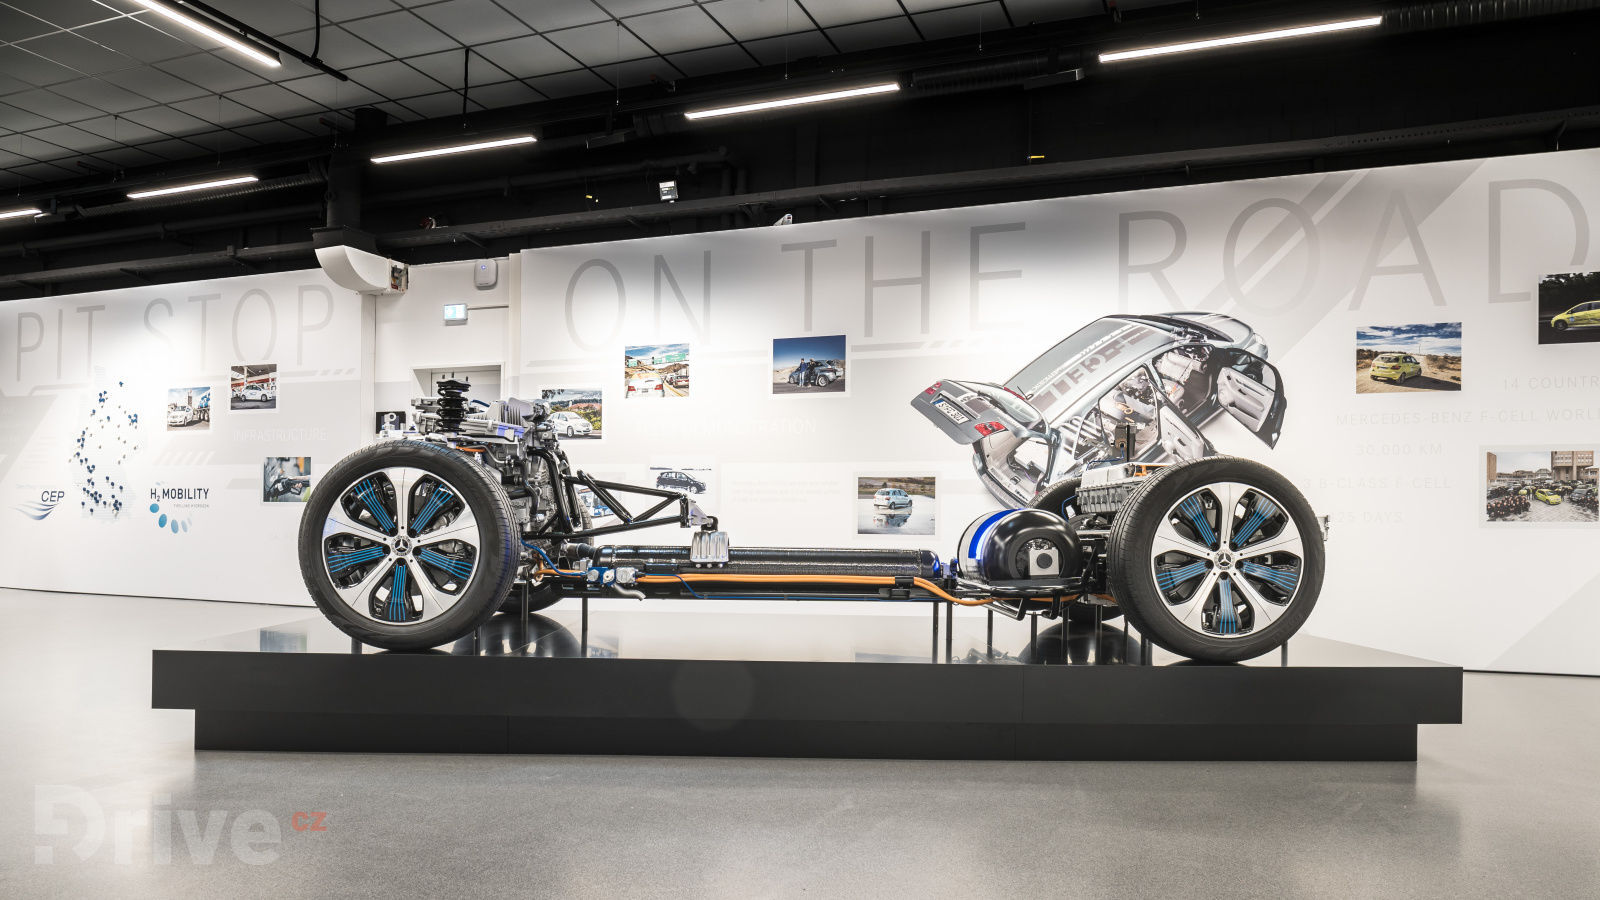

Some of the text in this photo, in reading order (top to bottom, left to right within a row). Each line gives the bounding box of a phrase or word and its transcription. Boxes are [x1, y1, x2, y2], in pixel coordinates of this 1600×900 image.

[565, 178, 1590, 352] ON THE ROAD
[17, 284, 335, 381] PIT STOP
[1545, 406, 1600, 422] WORL
[233, 427, 327, 442] INFRASTRUCTURE
[41, 490, 65, 502] CEP
[162, 487, 209, 500] MOBILITY
